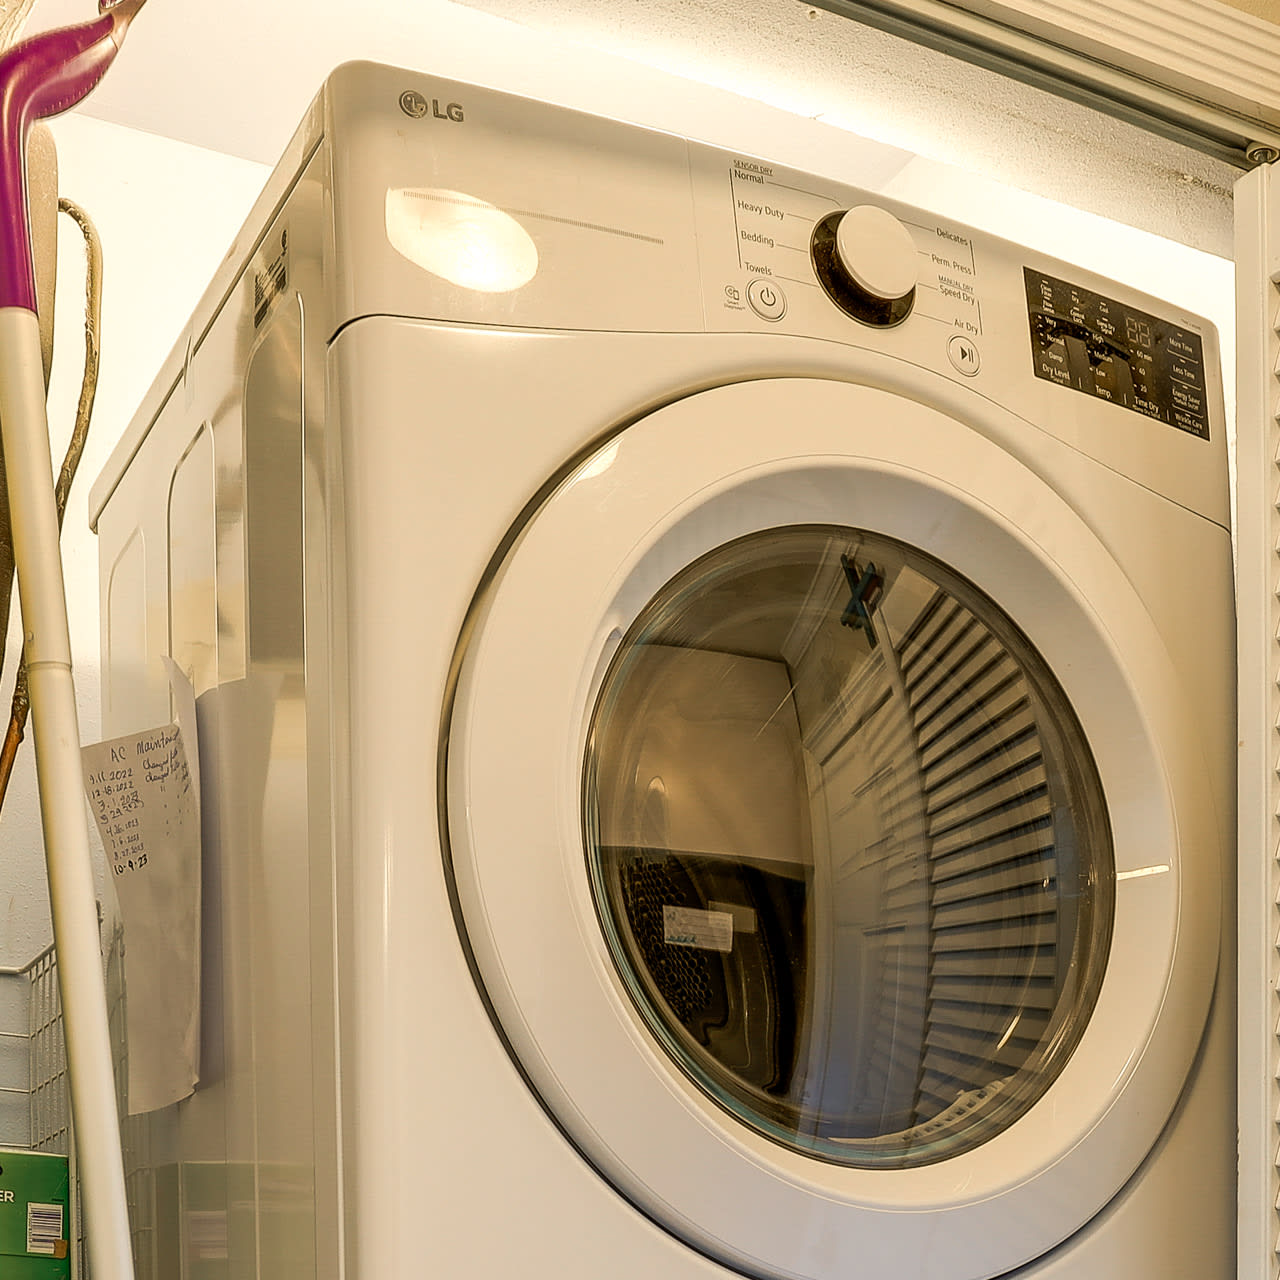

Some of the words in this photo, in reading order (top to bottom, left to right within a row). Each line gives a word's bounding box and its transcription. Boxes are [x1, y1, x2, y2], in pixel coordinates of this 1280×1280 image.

[432, 99, 464, 122] LG
[734, 170, 764, 184] Normal
[737, 200, 763, 215] Heavy
[764, 206, 785, 220] Duty
[740, 230, 774, 248] Bedding
[936, 227, 968, 246] Delicates
[744, 262, 772, 276] Towels
[931, 253, 951, 268] Perm.
[952, 261, 972, 275] Press
[939, 284, 961, 299] Speed
[962, 292, 975, 306] Dry
[954, 318, 964, 329] Air
[966, 322, 978, 336] Dry
